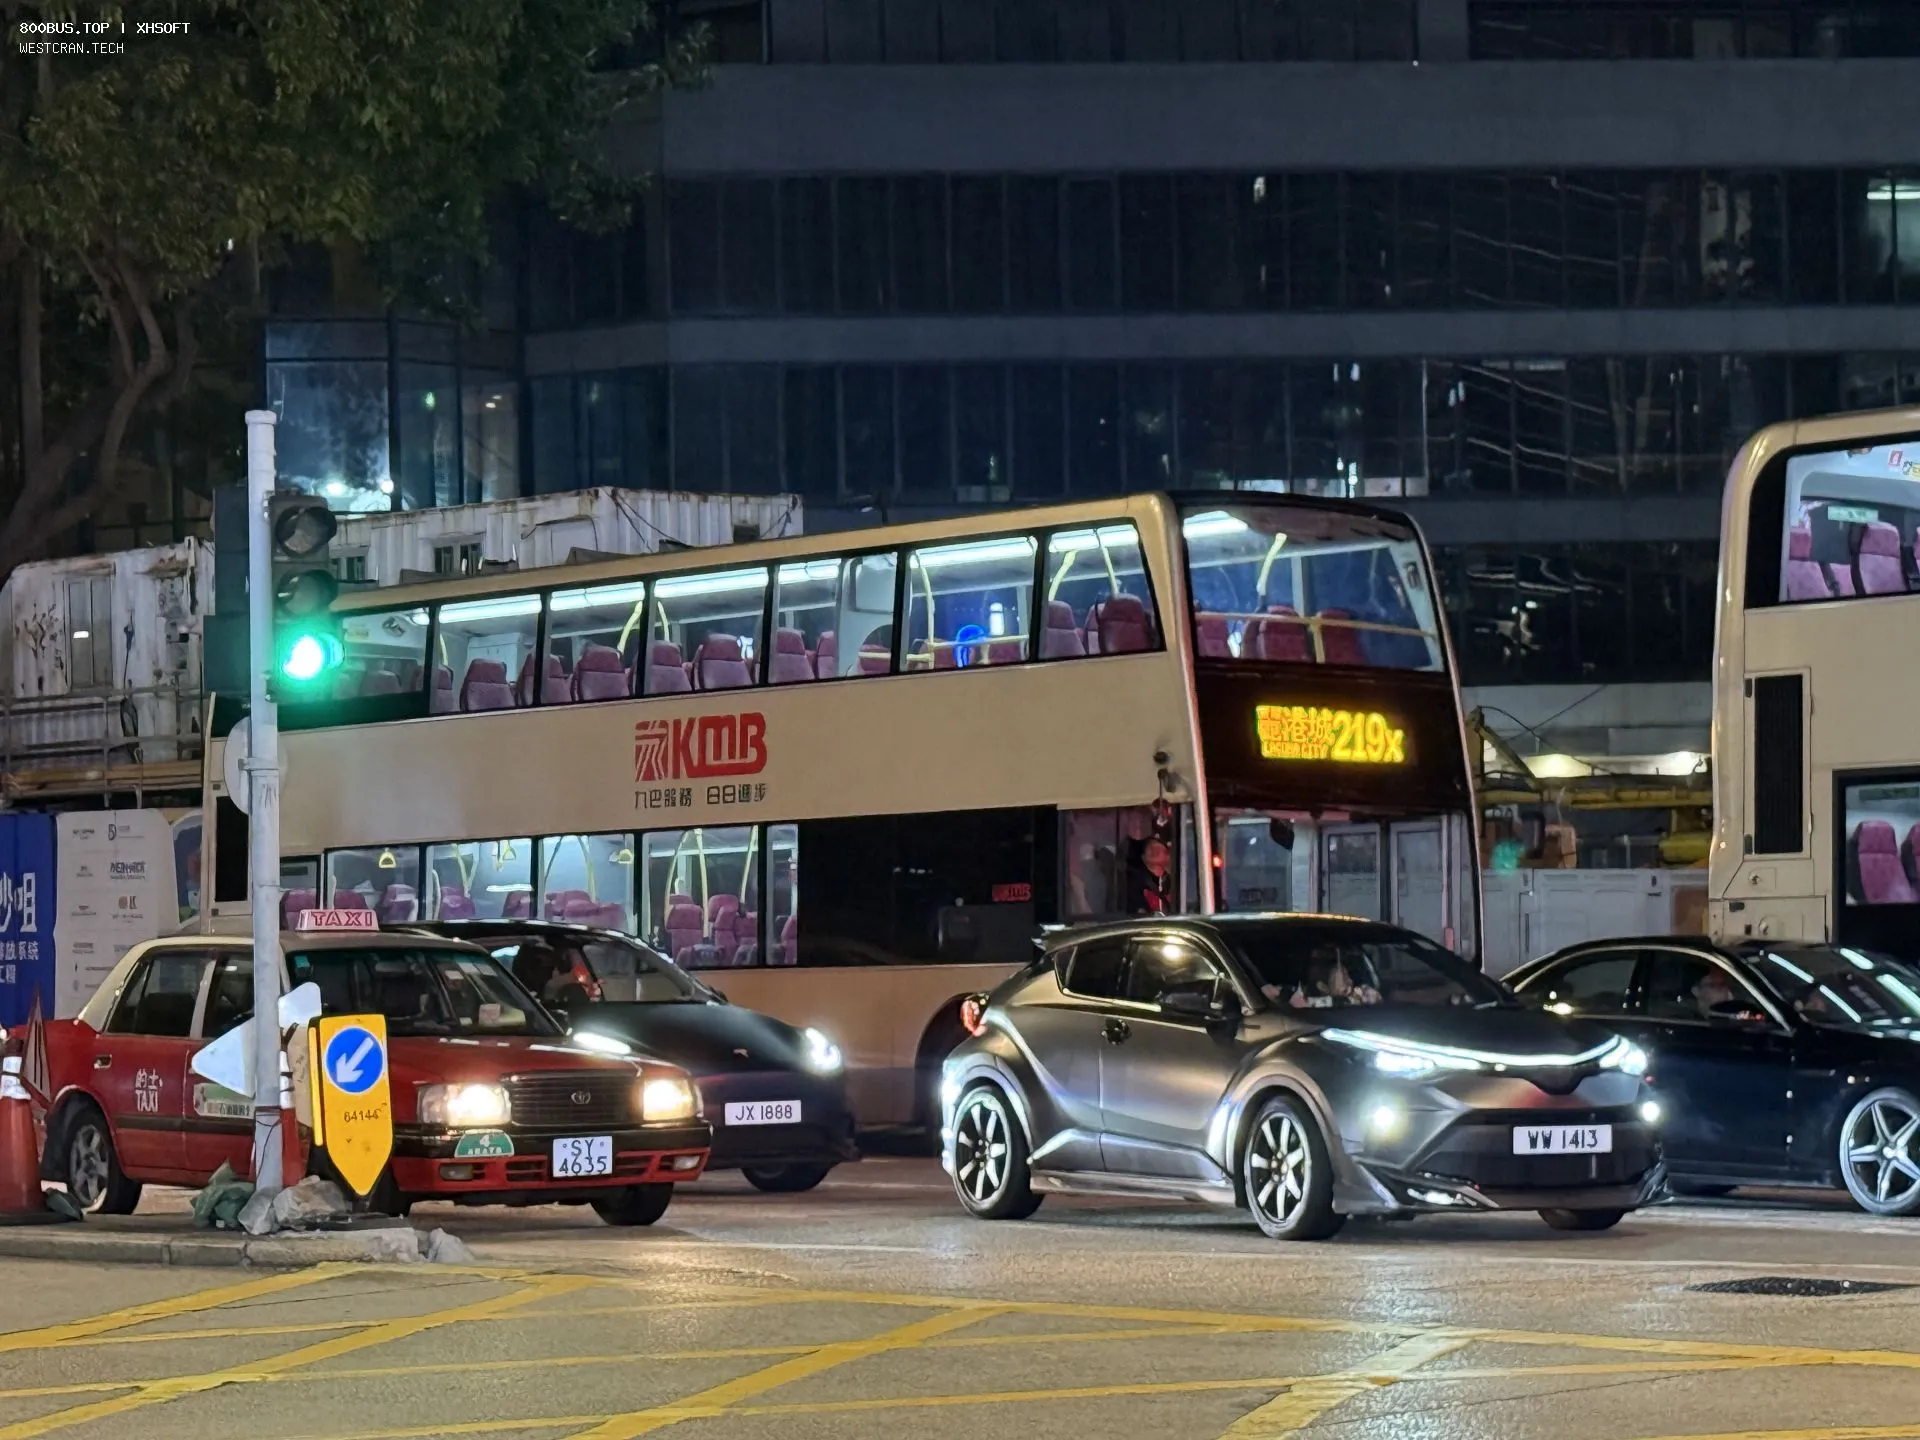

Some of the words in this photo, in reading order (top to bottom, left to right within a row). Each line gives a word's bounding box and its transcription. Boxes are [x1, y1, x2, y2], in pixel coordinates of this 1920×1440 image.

[672, 712, 768, 779] KMB
[1300, 743, 1329, 760] CITY
[635, 788, 693, 810] 九巴服務
[706, 783, 768, 805] 日日進步
[311, 911, 373, 927] TAXI
[134, 1068, 160, 1090] 的士
[135, 1090, 159, 1113] TAXI
[735, 1105, 755, 1121] JX
[760, 1104, 793, 1120] 1888
[479, 1134, 491, 1147] 4
[570, 1139, 595, 1157] SY
[1527, 1130, 1552, 1149] WW
[1561, 1129, 1598, 1149] 1413
[559, 1155, 608, 1175] 4635
